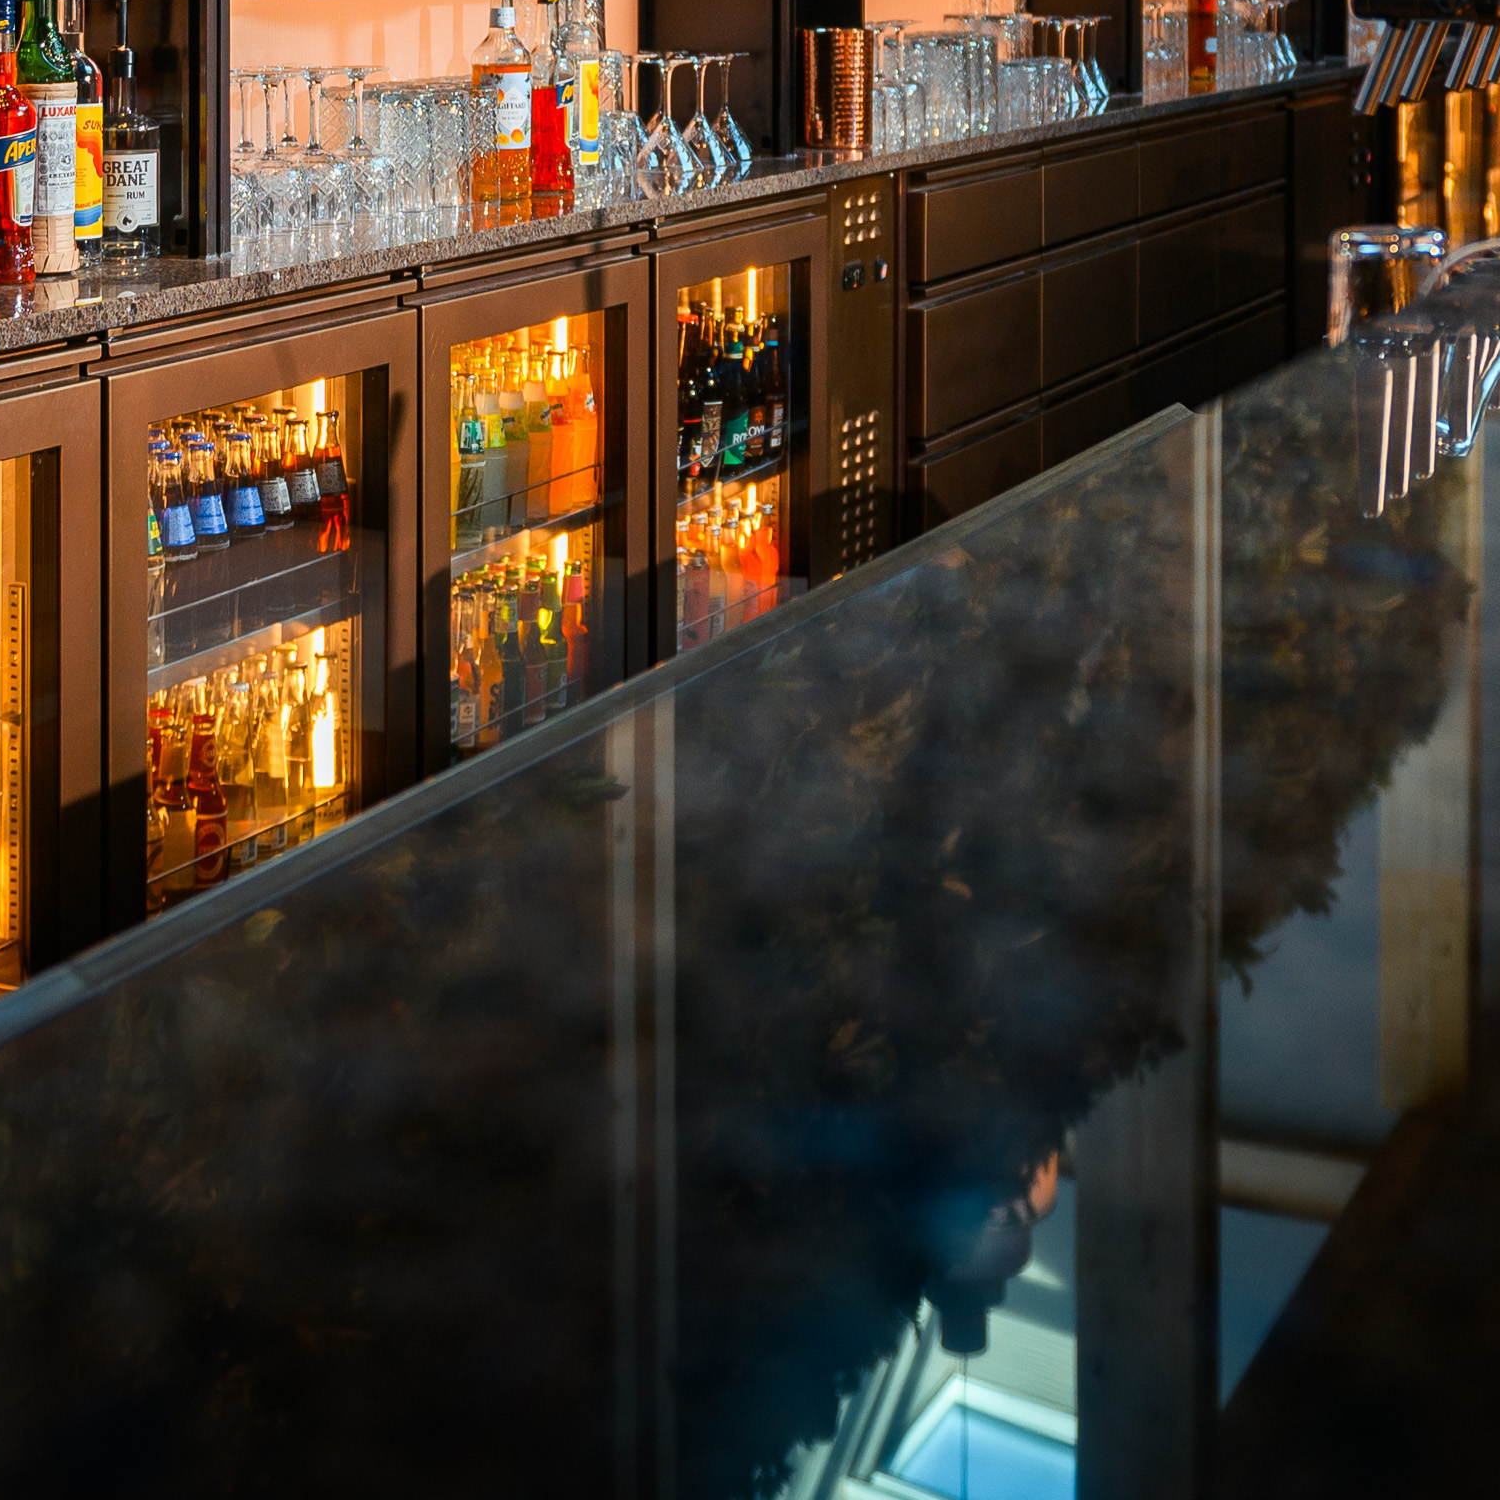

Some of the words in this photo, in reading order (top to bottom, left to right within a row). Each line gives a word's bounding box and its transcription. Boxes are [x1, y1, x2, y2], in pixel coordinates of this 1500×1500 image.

[102, 160, 150, 173] GREAT
[107, 173, 147, 187] DANE
[127, 191, 145, 200] RUM
